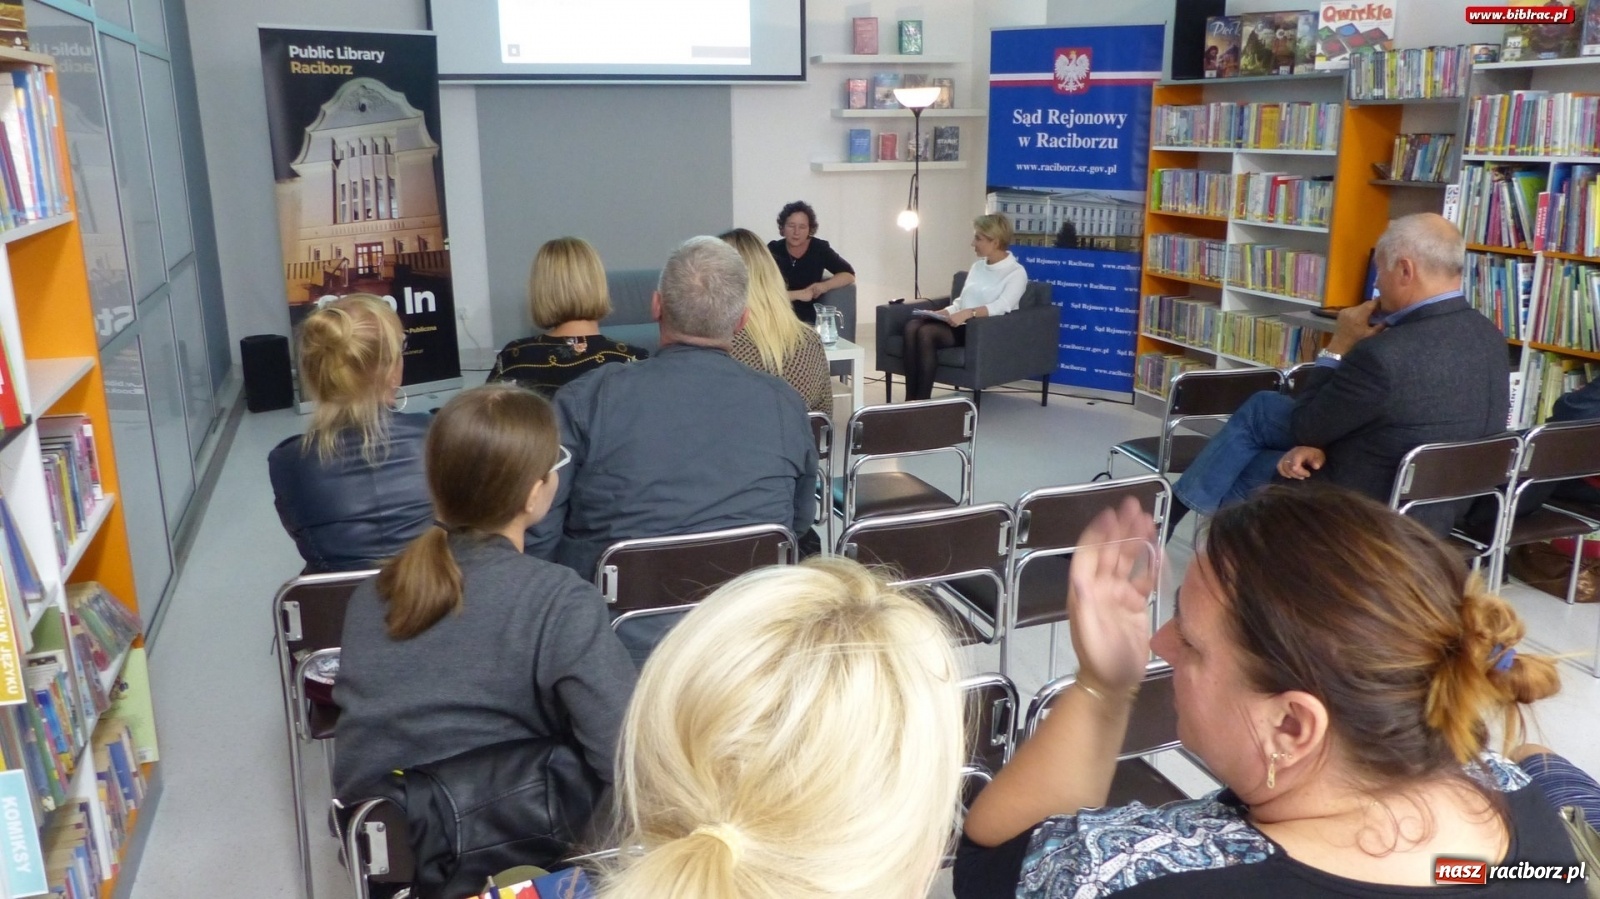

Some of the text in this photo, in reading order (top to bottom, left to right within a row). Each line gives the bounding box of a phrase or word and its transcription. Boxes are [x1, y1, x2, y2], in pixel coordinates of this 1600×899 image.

[1322, 3, 1393, 23] Qwirkle
[288, 45, 385, 63] Public Library
[290, 61, 354, 75] Raciborz
[1012, 109, 1128, 129] Sąd Rejonowy
[1018, 132, 1119, 149] w Raciborzu
[1016, 162, 1117, 176] www.raciborz.sr.gov.pl
[403, 286, 437, 315] In
[3, 796, 32, 873] KOMIKSY
